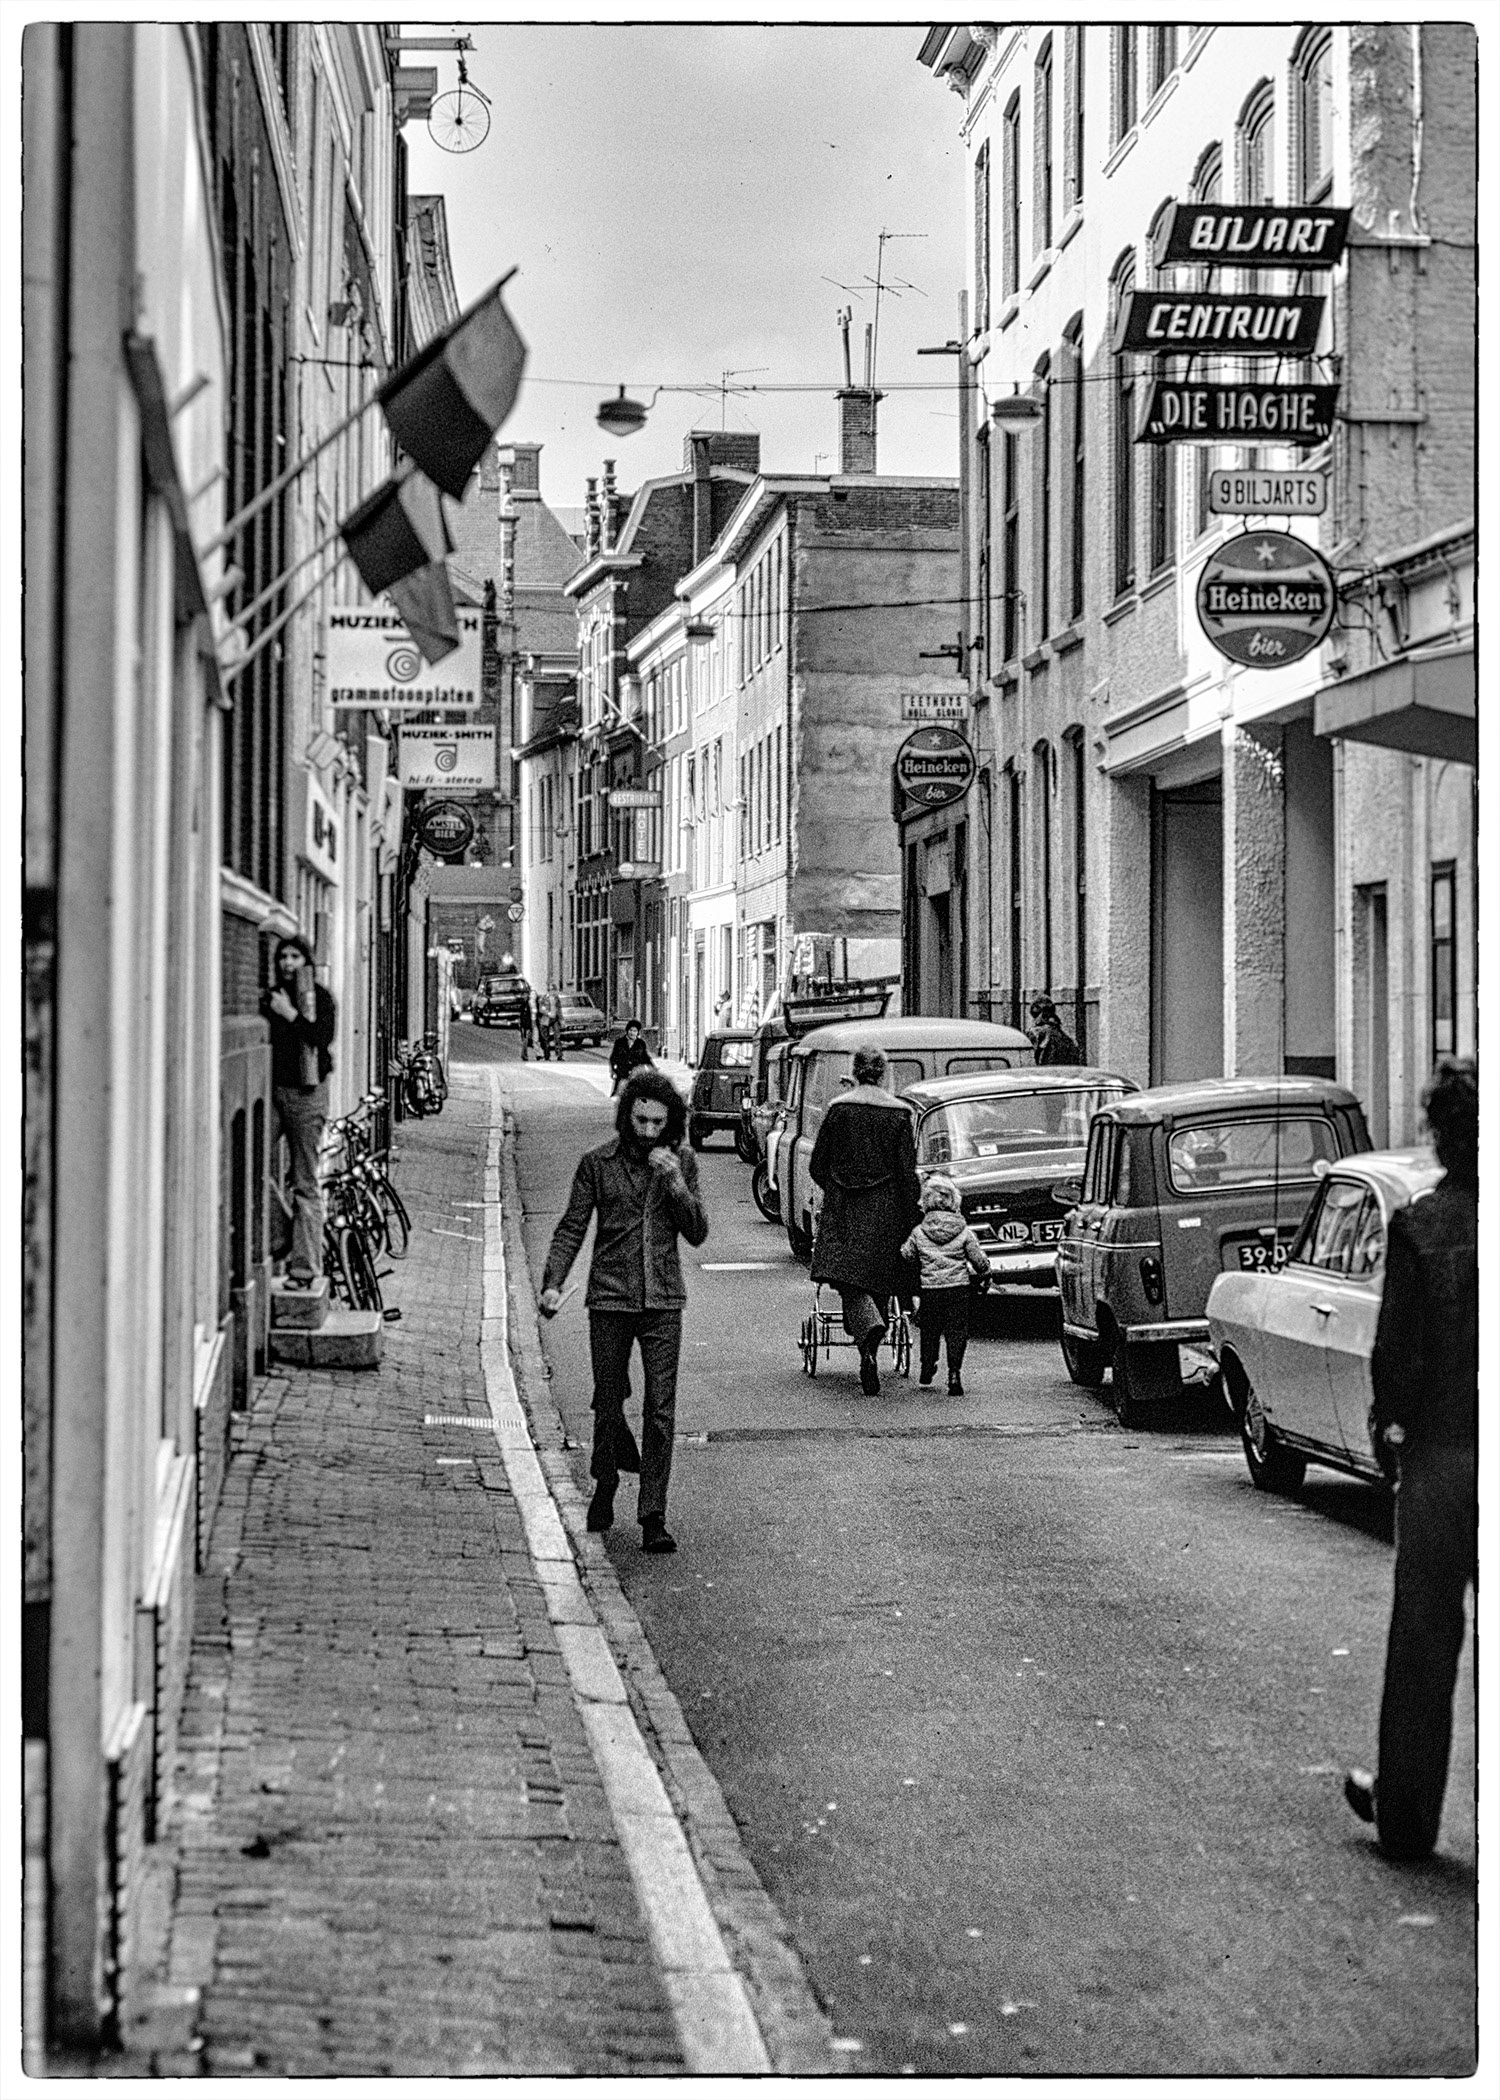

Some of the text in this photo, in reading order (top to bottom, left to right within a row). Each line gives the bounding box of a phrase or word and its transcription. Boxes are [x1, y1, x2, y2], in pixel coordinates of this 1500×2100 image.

[1190, 216, 1335, 252] BILJART
[1146, 304, 1302, 340] CENTRUM
[1220, 479, 1317, 505] 9 BILJARTS
[1208, 585, 1323, 611] Heineken
[1250, 632, 1286, 657] bier
[331, 686, 475, 705] grammofoonplaten
[402, 730, 493, 740] MUZIEK-SMITH
[904, 759, 968, 774] Heineken
[408, 775, 434, 784] hi-fi
[445, 775, 483, 784] stereo
[925, 785, 947, 800] bier
[428, 820, 464, 829] AMSTEL
[434, 829, 456, 838] BIER
[637, 810, 646, 860] HOTEL
[1002, 1225, 1024, 1240] NL
